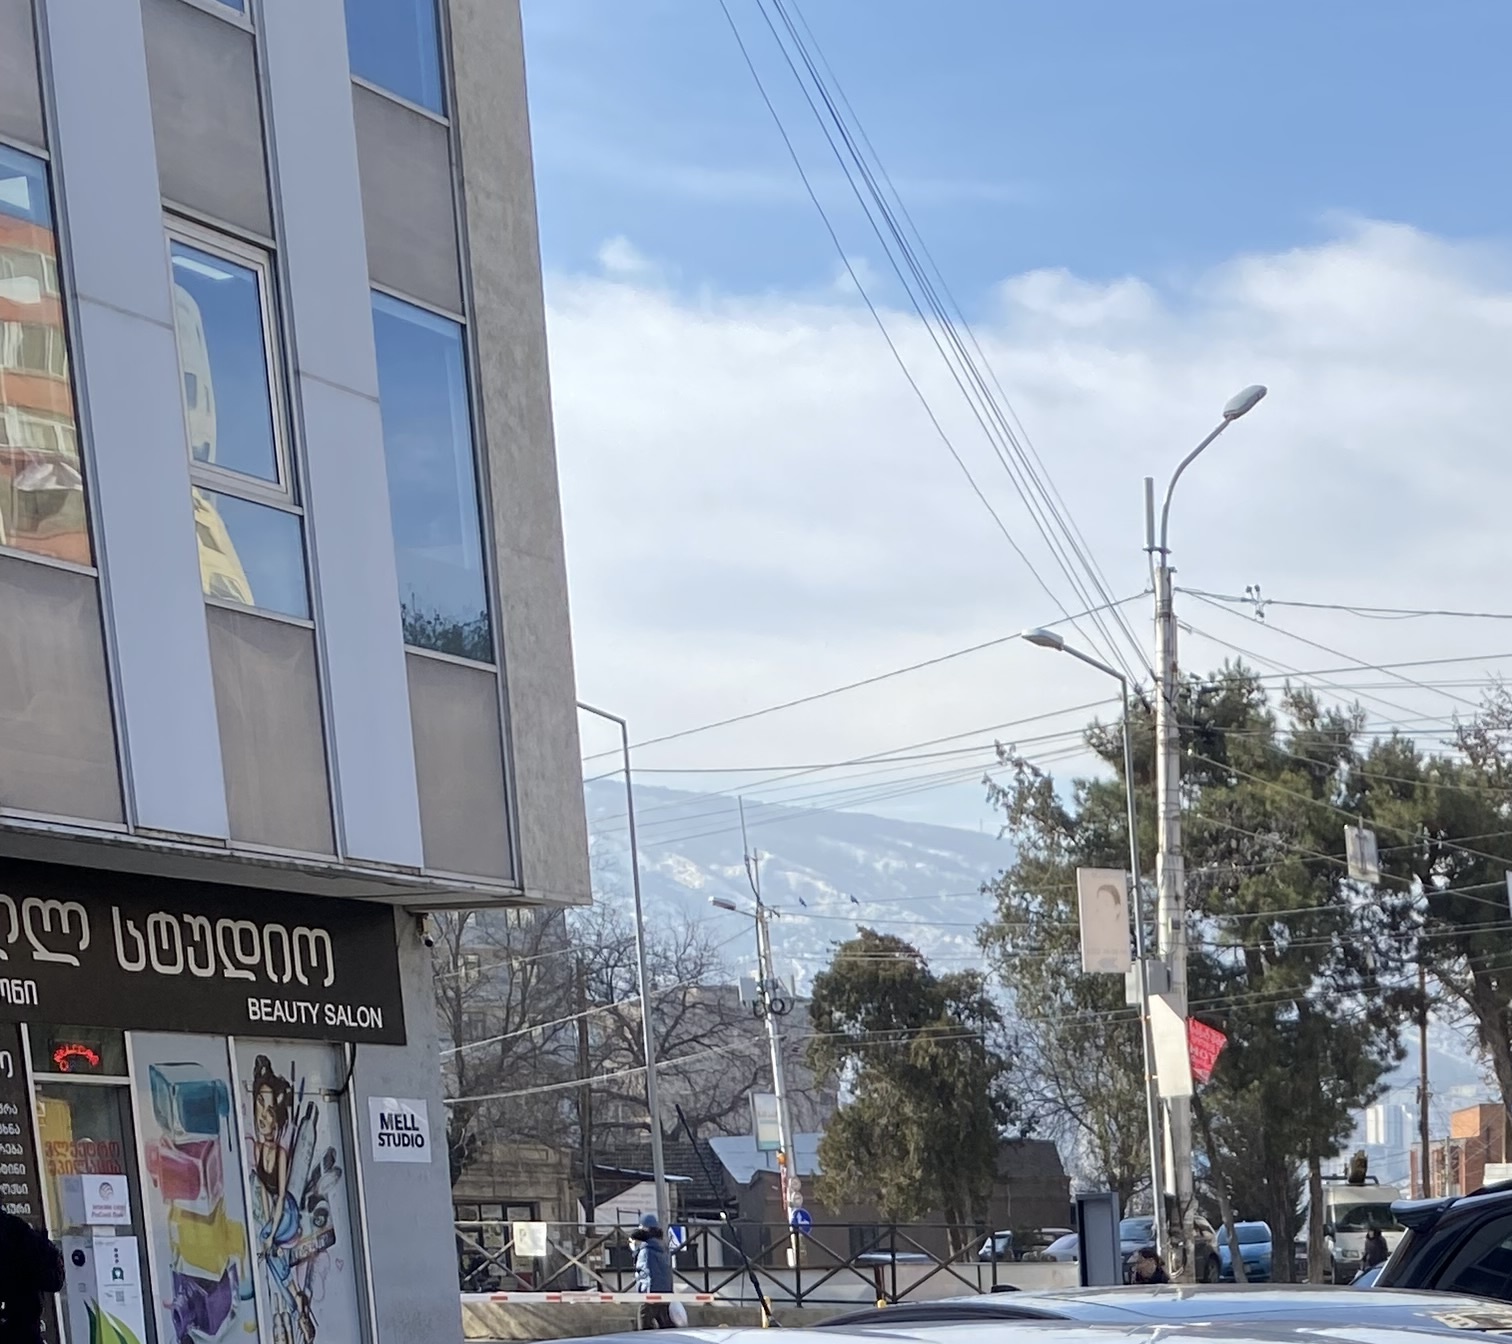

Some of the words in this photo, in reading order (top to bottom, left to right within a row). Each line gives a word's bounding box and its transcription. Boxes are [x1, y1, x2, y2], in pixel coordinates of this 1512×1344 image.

[111, 905, 336, 988] სტუდიო
[247, 998, 320, 1025] BEAUTY
[324, 1004, 384, 1029] SALON
[380, 1112, 420, 1131] MELL
[378, 1132, 425, 1148] STUDIO
